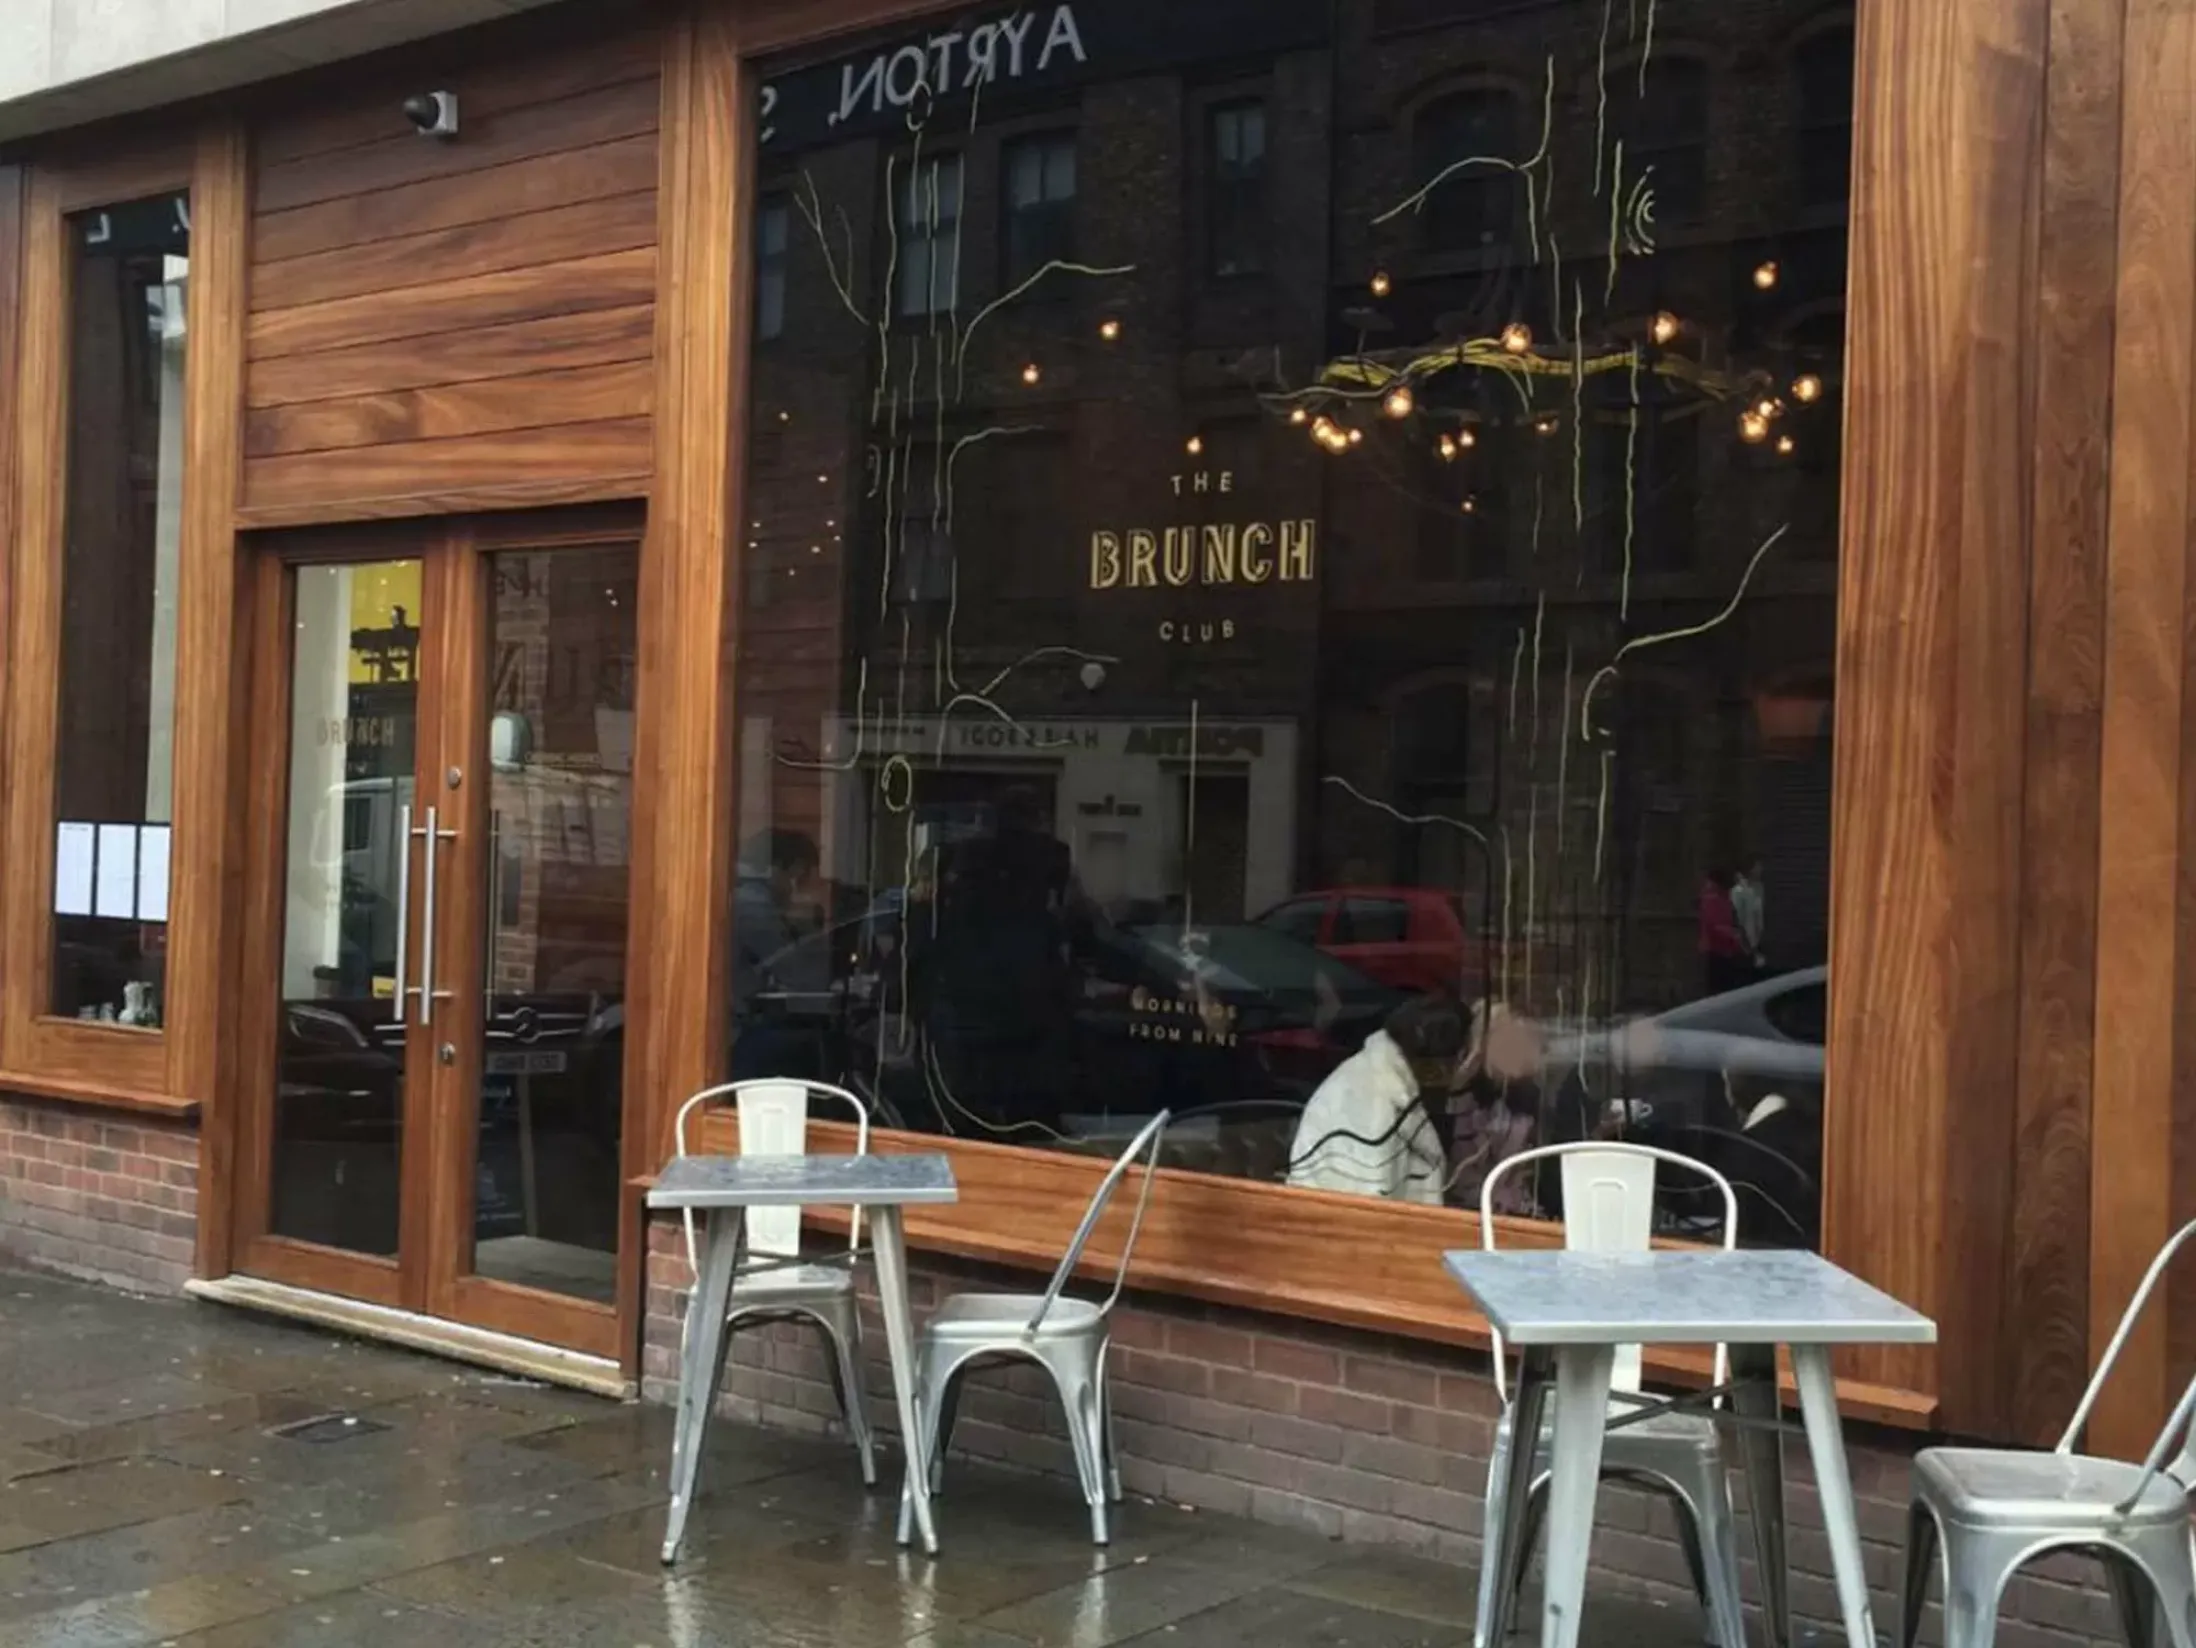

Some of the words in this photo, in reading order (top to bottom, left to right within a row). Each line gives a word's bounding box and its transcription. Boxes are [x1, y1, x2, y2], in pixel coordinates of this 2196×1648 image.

[1170, 471, 1233, 496] THE
[1090, 519, 1315, 589] BRUNCH
[1159, 619, 1235, 642] CLUB
[1129, 1024, 1181, 1041] FROM
